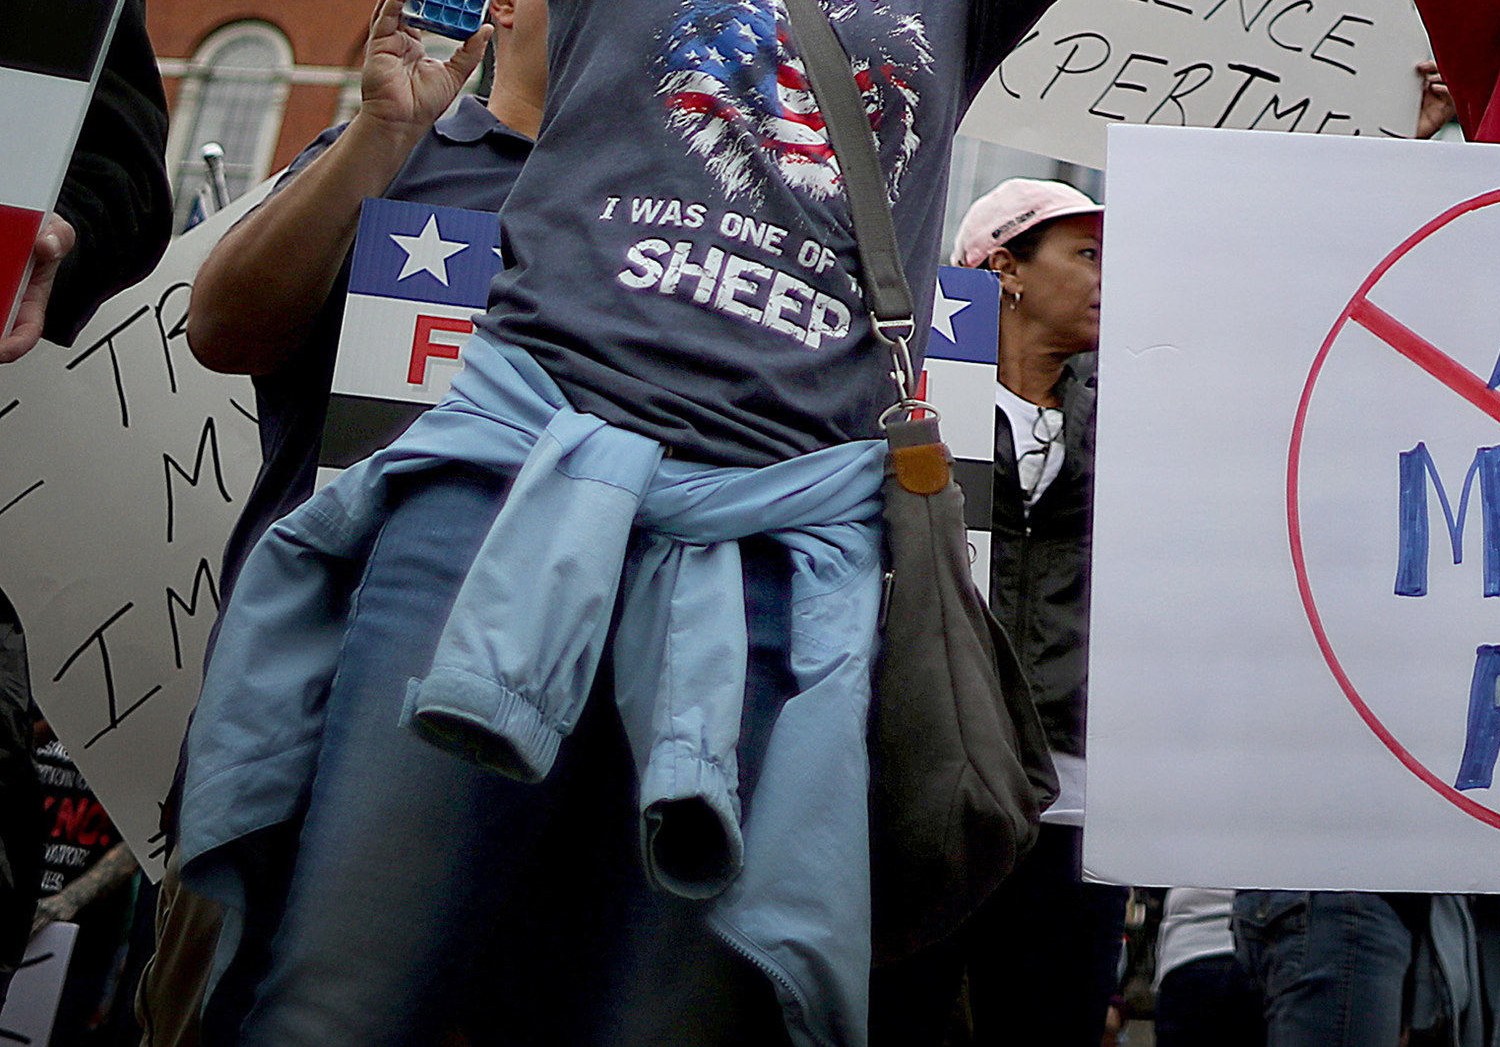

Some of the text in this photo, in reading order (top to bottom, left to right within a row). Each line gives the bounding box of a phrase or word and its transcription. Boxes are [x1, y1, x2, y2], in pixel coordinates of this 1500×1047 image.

[599, 197, 837, 274] I WAS ONE OF
[617, 238, 852, 350] SHEEP
